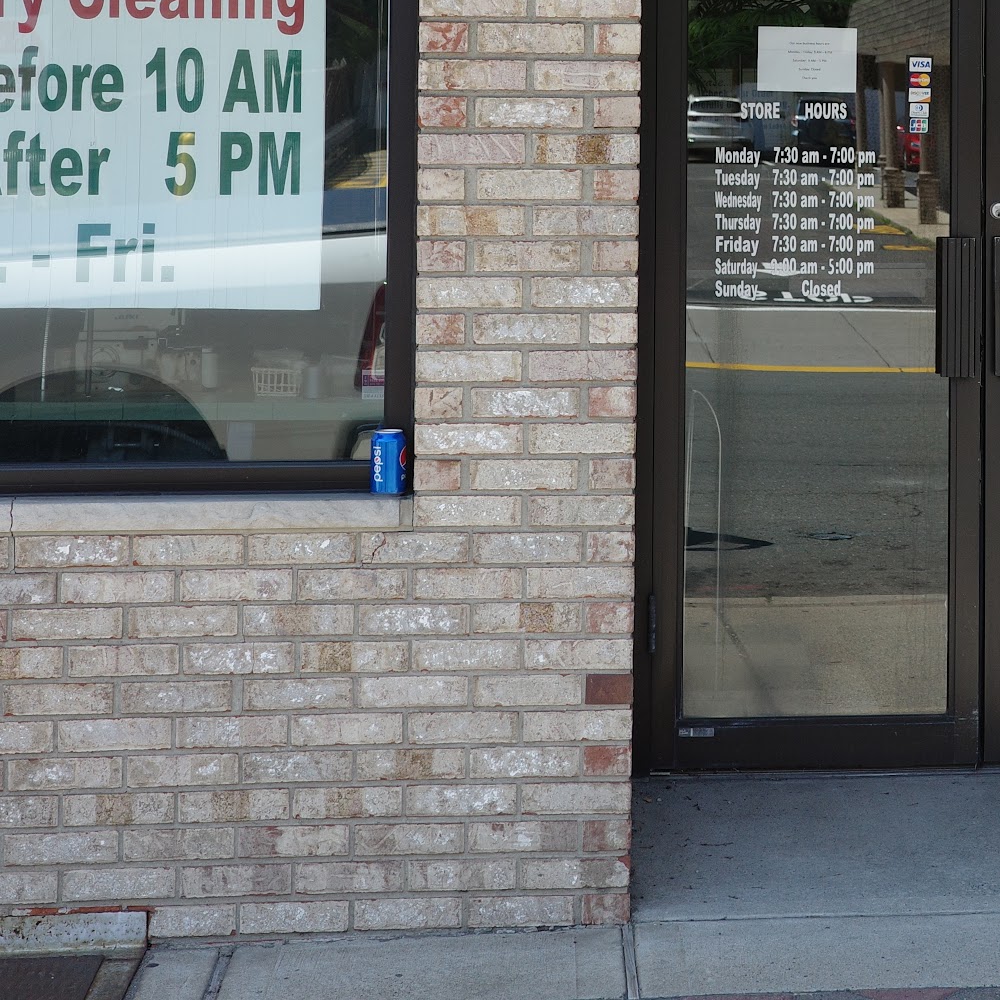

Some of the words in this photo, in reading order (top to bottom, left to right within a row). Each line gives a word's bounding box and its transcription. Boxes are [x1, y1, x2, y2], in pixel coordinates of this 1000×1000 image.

[911, 60, 931, 69] VISA
[145, 47, 205, 114] 10
[222, 49, 303, 113] AM
[740, 102, 781, 120] STORE
[804, 102, 848, 120] HOURS
[0, 130, 111, 197] fter
[165, 131, 197, 197] 5
[219, 131, 302, 196] PM
[715, 146, 761, 167] Monday
[773, 146, 798, 163] 7:30
[802, 150, 820, 163] am
[830, 146, 855, 163] 7:00
[858, 150, 876, 167] pm
[715, 168, 760, 190] Tuesday
[772, 168, 797, 186] 7:30
[800, 172, 818, 186] am
[828, 168, 854, 186] 7:00
[857, 172, 874, 190] pm
[714, 191, 762, 212] Wednesday
[772, 191, 797, 208] 7:30
[800, 195, 818, 208] am
[828, 191, 854, 208] 7:00
[857, 195, 874, 212] pm
[715, 213, 761, 234] Thursday
[772, 213, 797, 230] 7:30
[800, 217, 818, 230] am
[828, 213, 854, 230] 7:00
[857, 217, 874, 234] pm
[76, 223, 175, 282] Fri.
[715, 236, 760, 256] Friday
[772, 236, 797, 252] 7:30
[800, 240, 818, 252] am
[828, 236, 854, 252] 7:00
[857, 240, 874, 256] pm
[715, 258, 758, 279] Saturday
[800, 262, 818, 275] am
[828, 258, 854, 275] 5:00
[857, 262, 874, 279] pm
[715, 280, 758, 301] Sunday
[801, 280, 842, 297] Closed
[373, 445, 384, 482] pepsi
